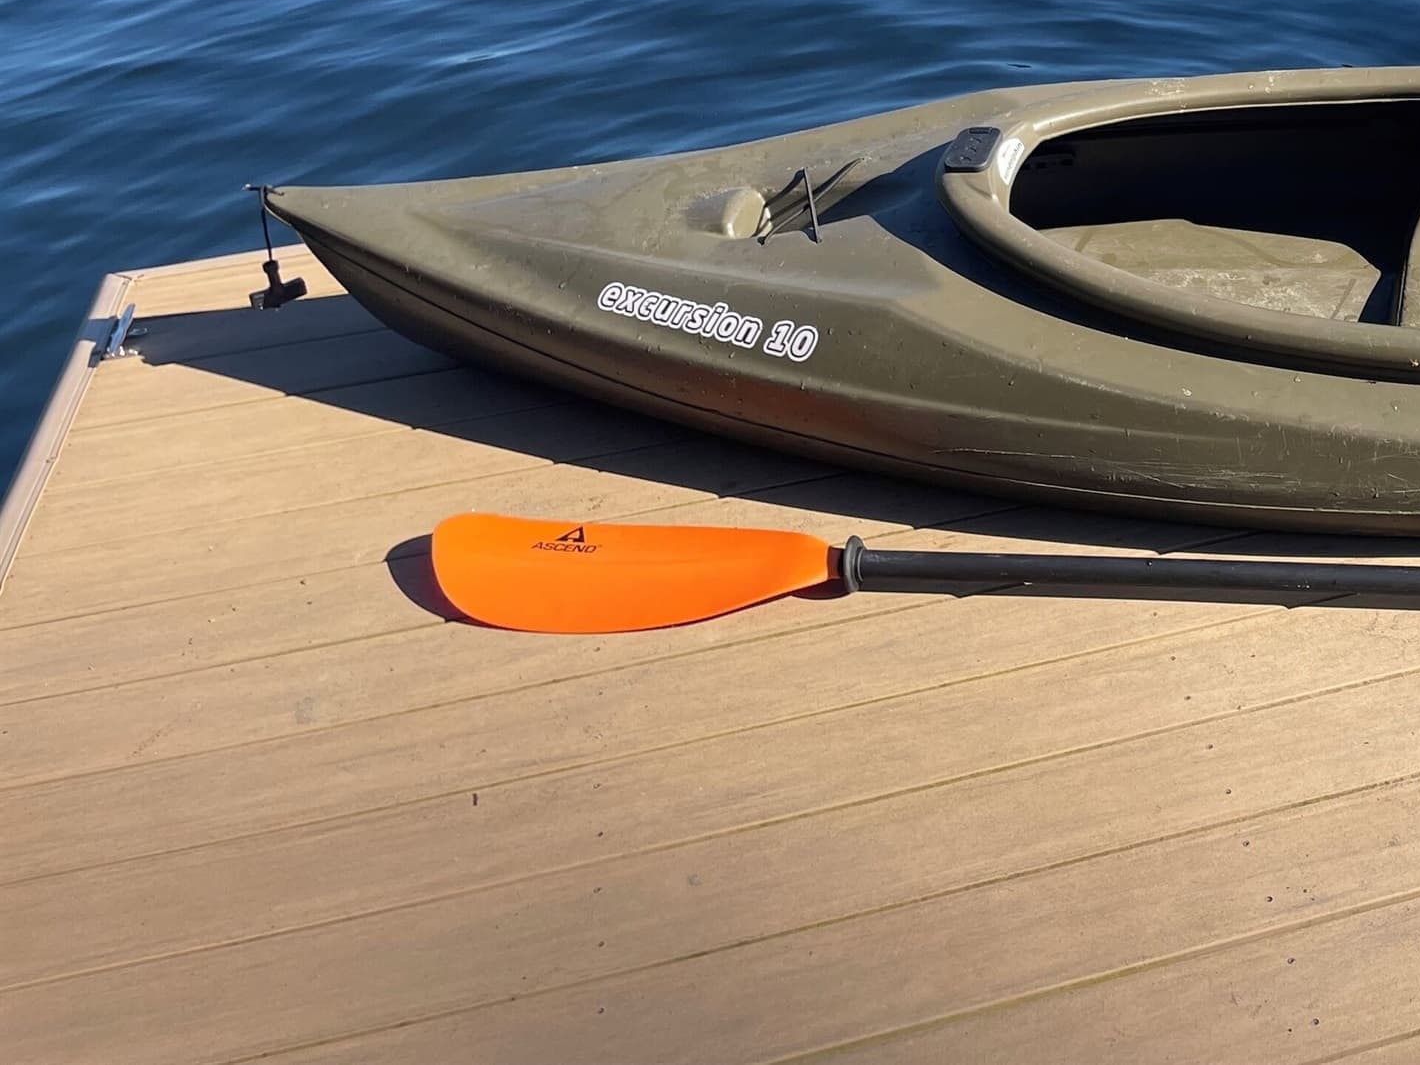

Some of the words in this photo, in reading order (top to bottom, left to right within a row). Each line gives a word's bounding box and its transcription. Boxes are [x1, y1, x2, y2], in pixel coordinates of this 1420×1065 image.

[598, 283, 762, 347] excursion
[764, 321, 818, 361] 10
[531, 541, 598, 554] ASCEND
